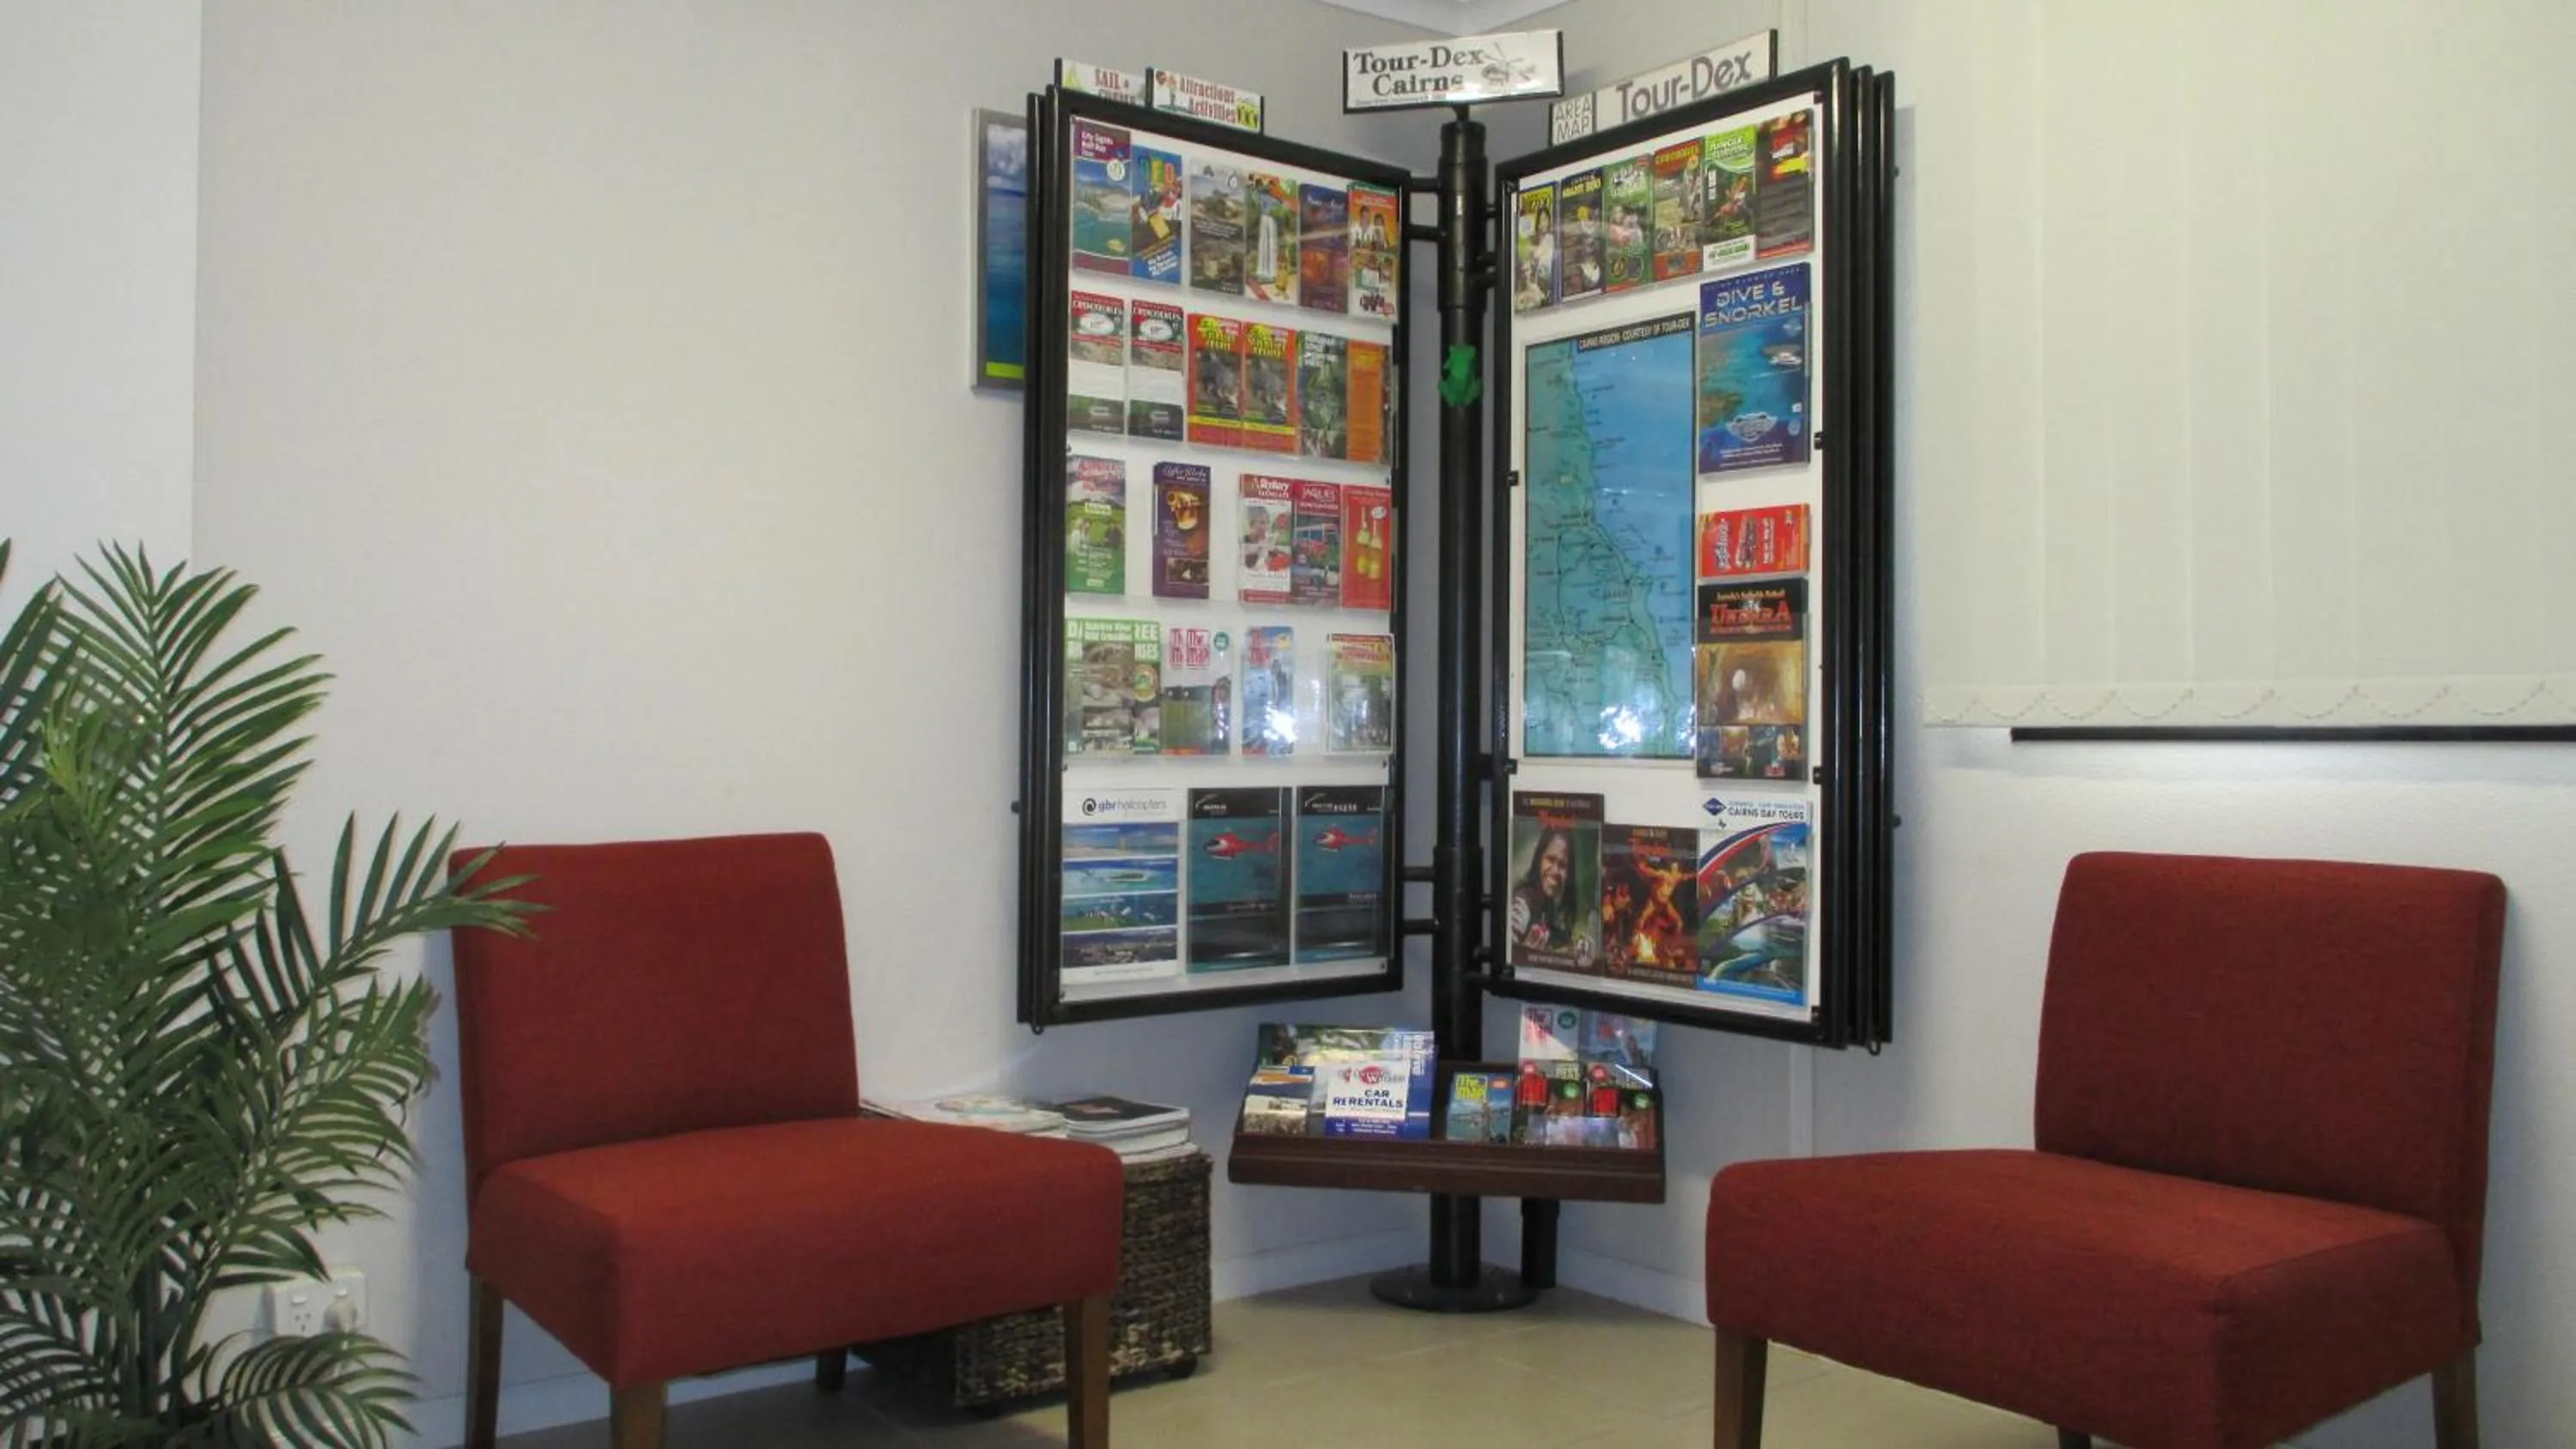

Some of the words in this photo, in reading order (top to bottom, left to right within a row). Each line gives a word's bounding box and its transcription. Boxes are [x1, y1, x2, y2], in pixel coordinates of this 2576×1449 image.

[1353, 45, 1484, 74] Tour-Dex
[1372, 73, 1465, 96] Cairns
[1616, 52, 1752, 122] Tour-Dex
[1555, 96, 1591, 122] AREA
[1556, 115, 1589, 143] MAP
[1716, 282, 1765, 307] DIVE
[1704, 295, 1803, 328] SNORKEL
[1098, 799, 1116, 813] gbr
[1348, 1097, 1403, 1109] RENTALS
[1364, 1089, 1390, 1100] CAR
